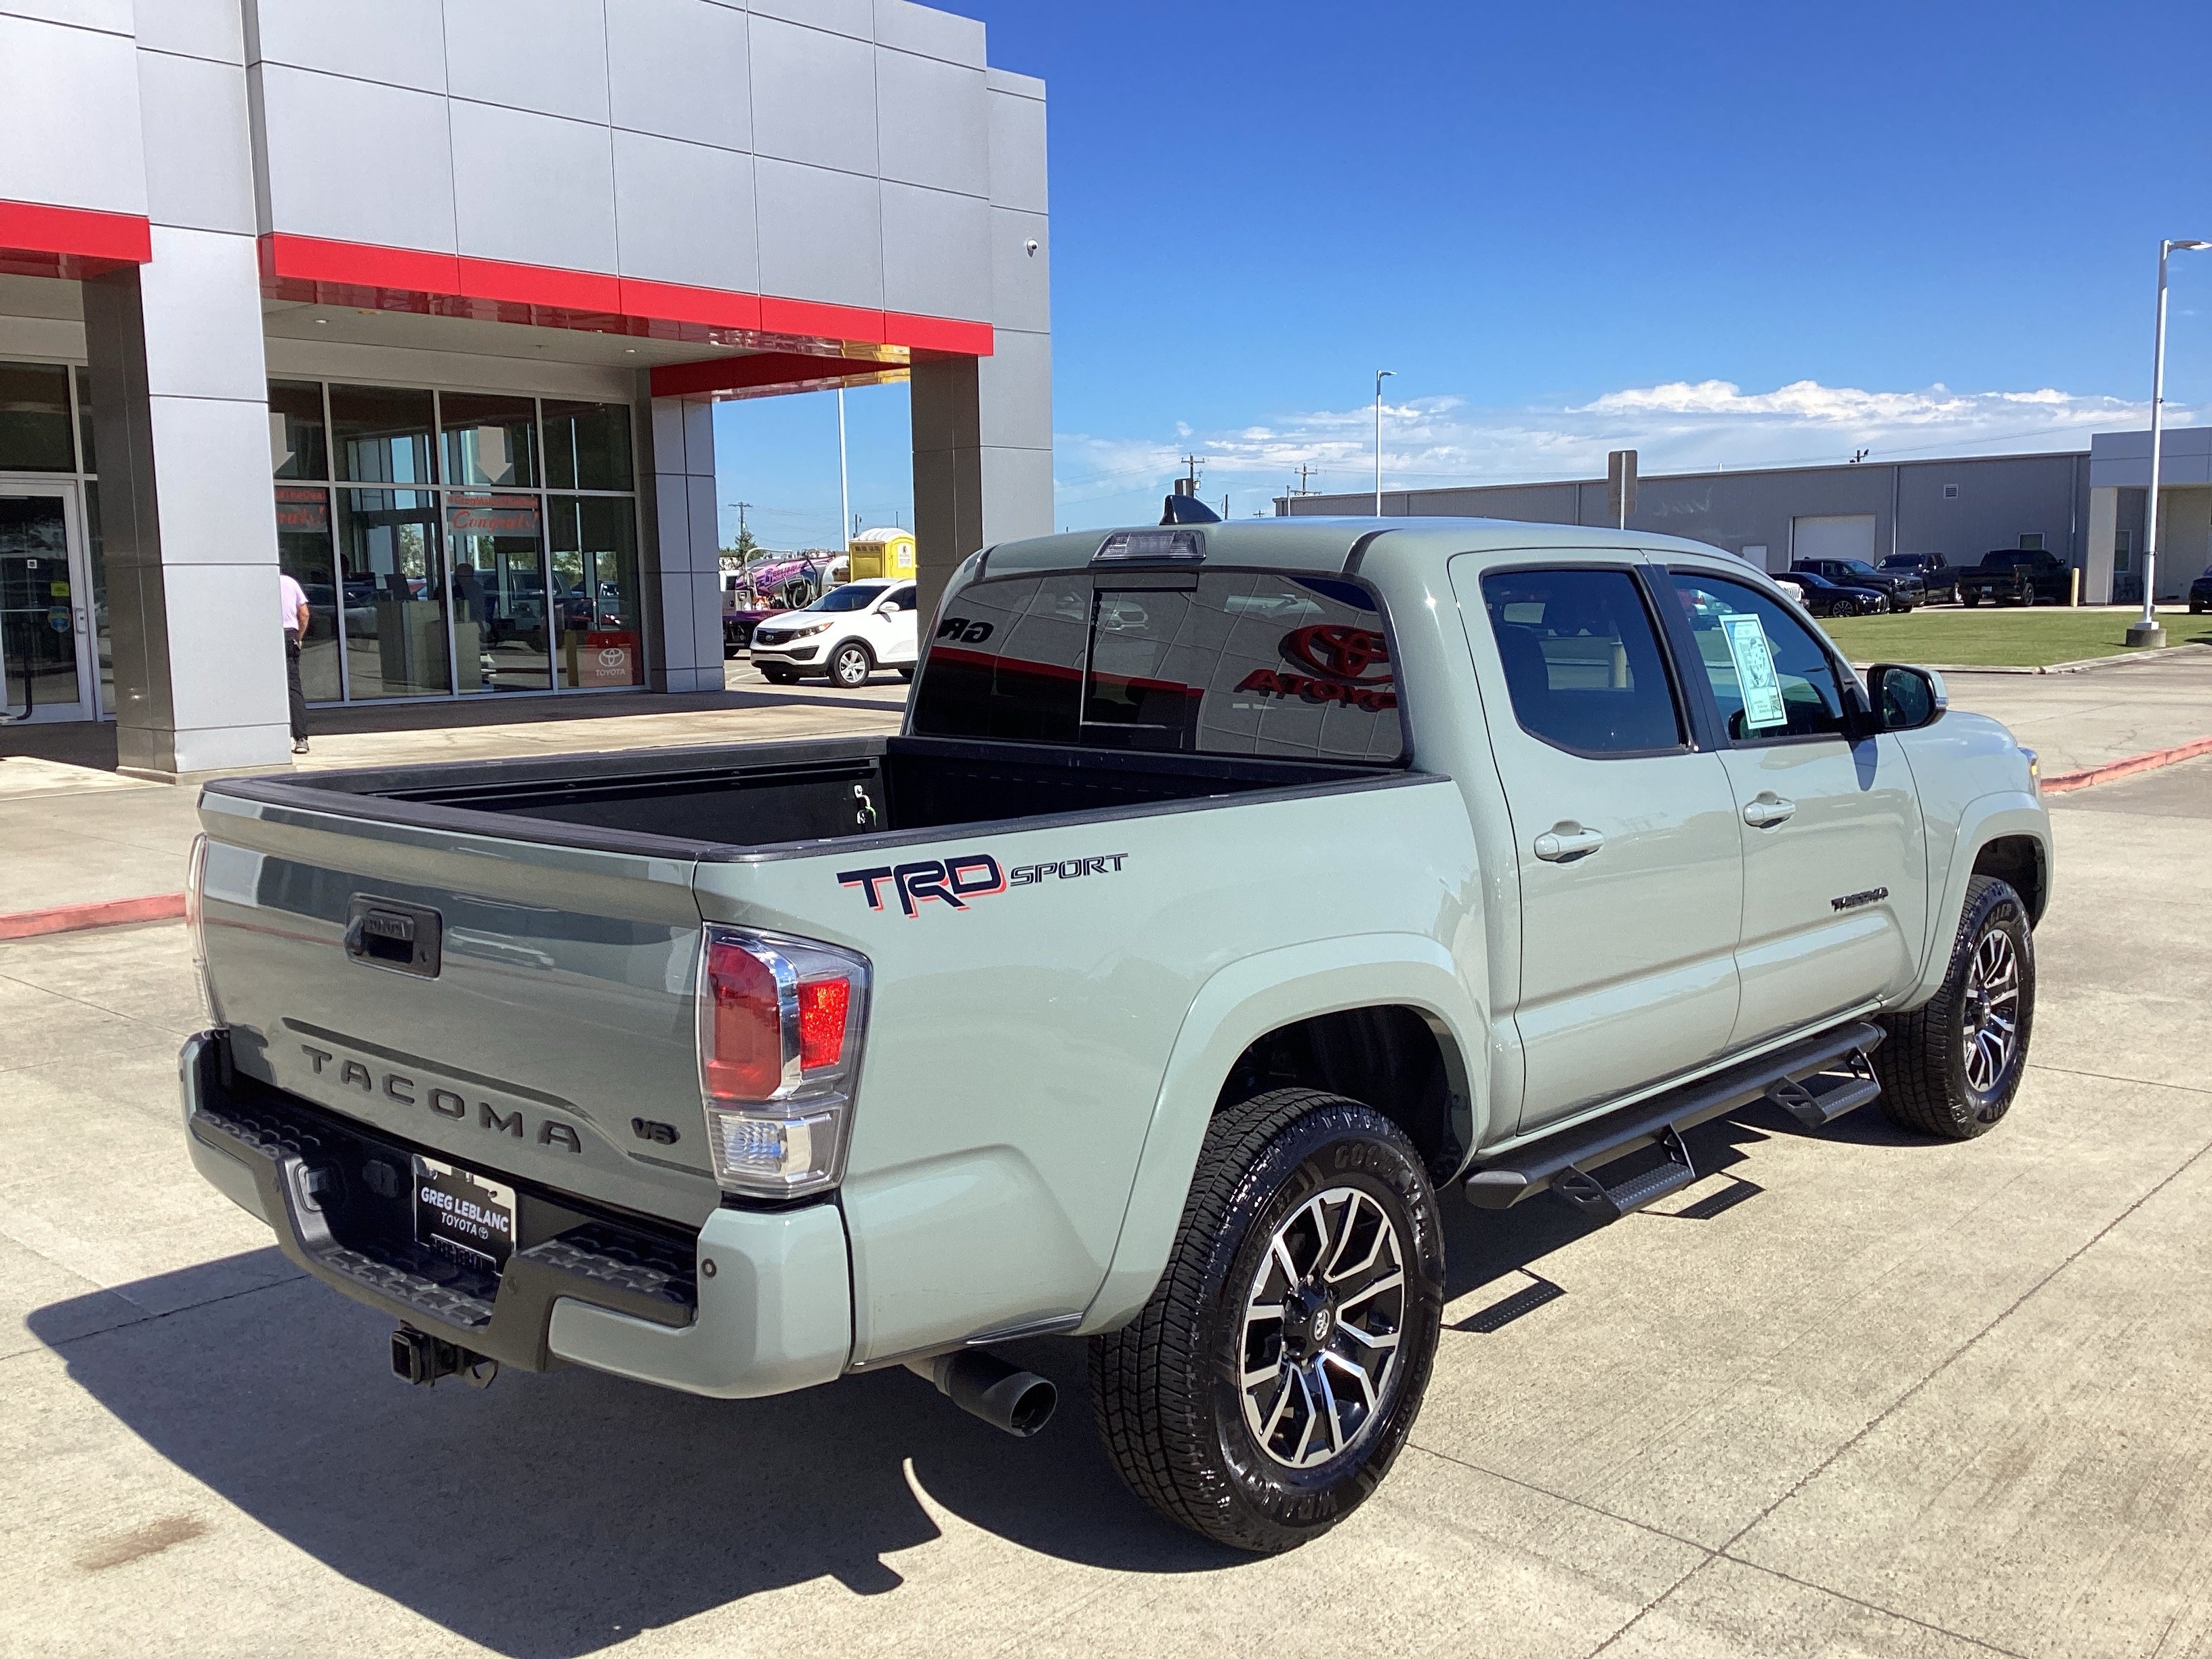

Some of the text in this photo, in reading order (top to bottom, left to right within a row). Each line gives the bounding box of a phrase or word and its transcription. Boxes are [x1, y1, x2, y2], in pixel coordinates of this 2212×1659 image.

[596, 668, 626, 676] TOYOTA
[836, 853, 1128, 919] TRD SPORT
[302, 1044, 581, 1154] TACOMA
[630, 1117, 680, 1145] V6
[421, 1187, 509, 1233] GREG LEBLANC
[441, 1212, 477, 1236] TOYOTA
